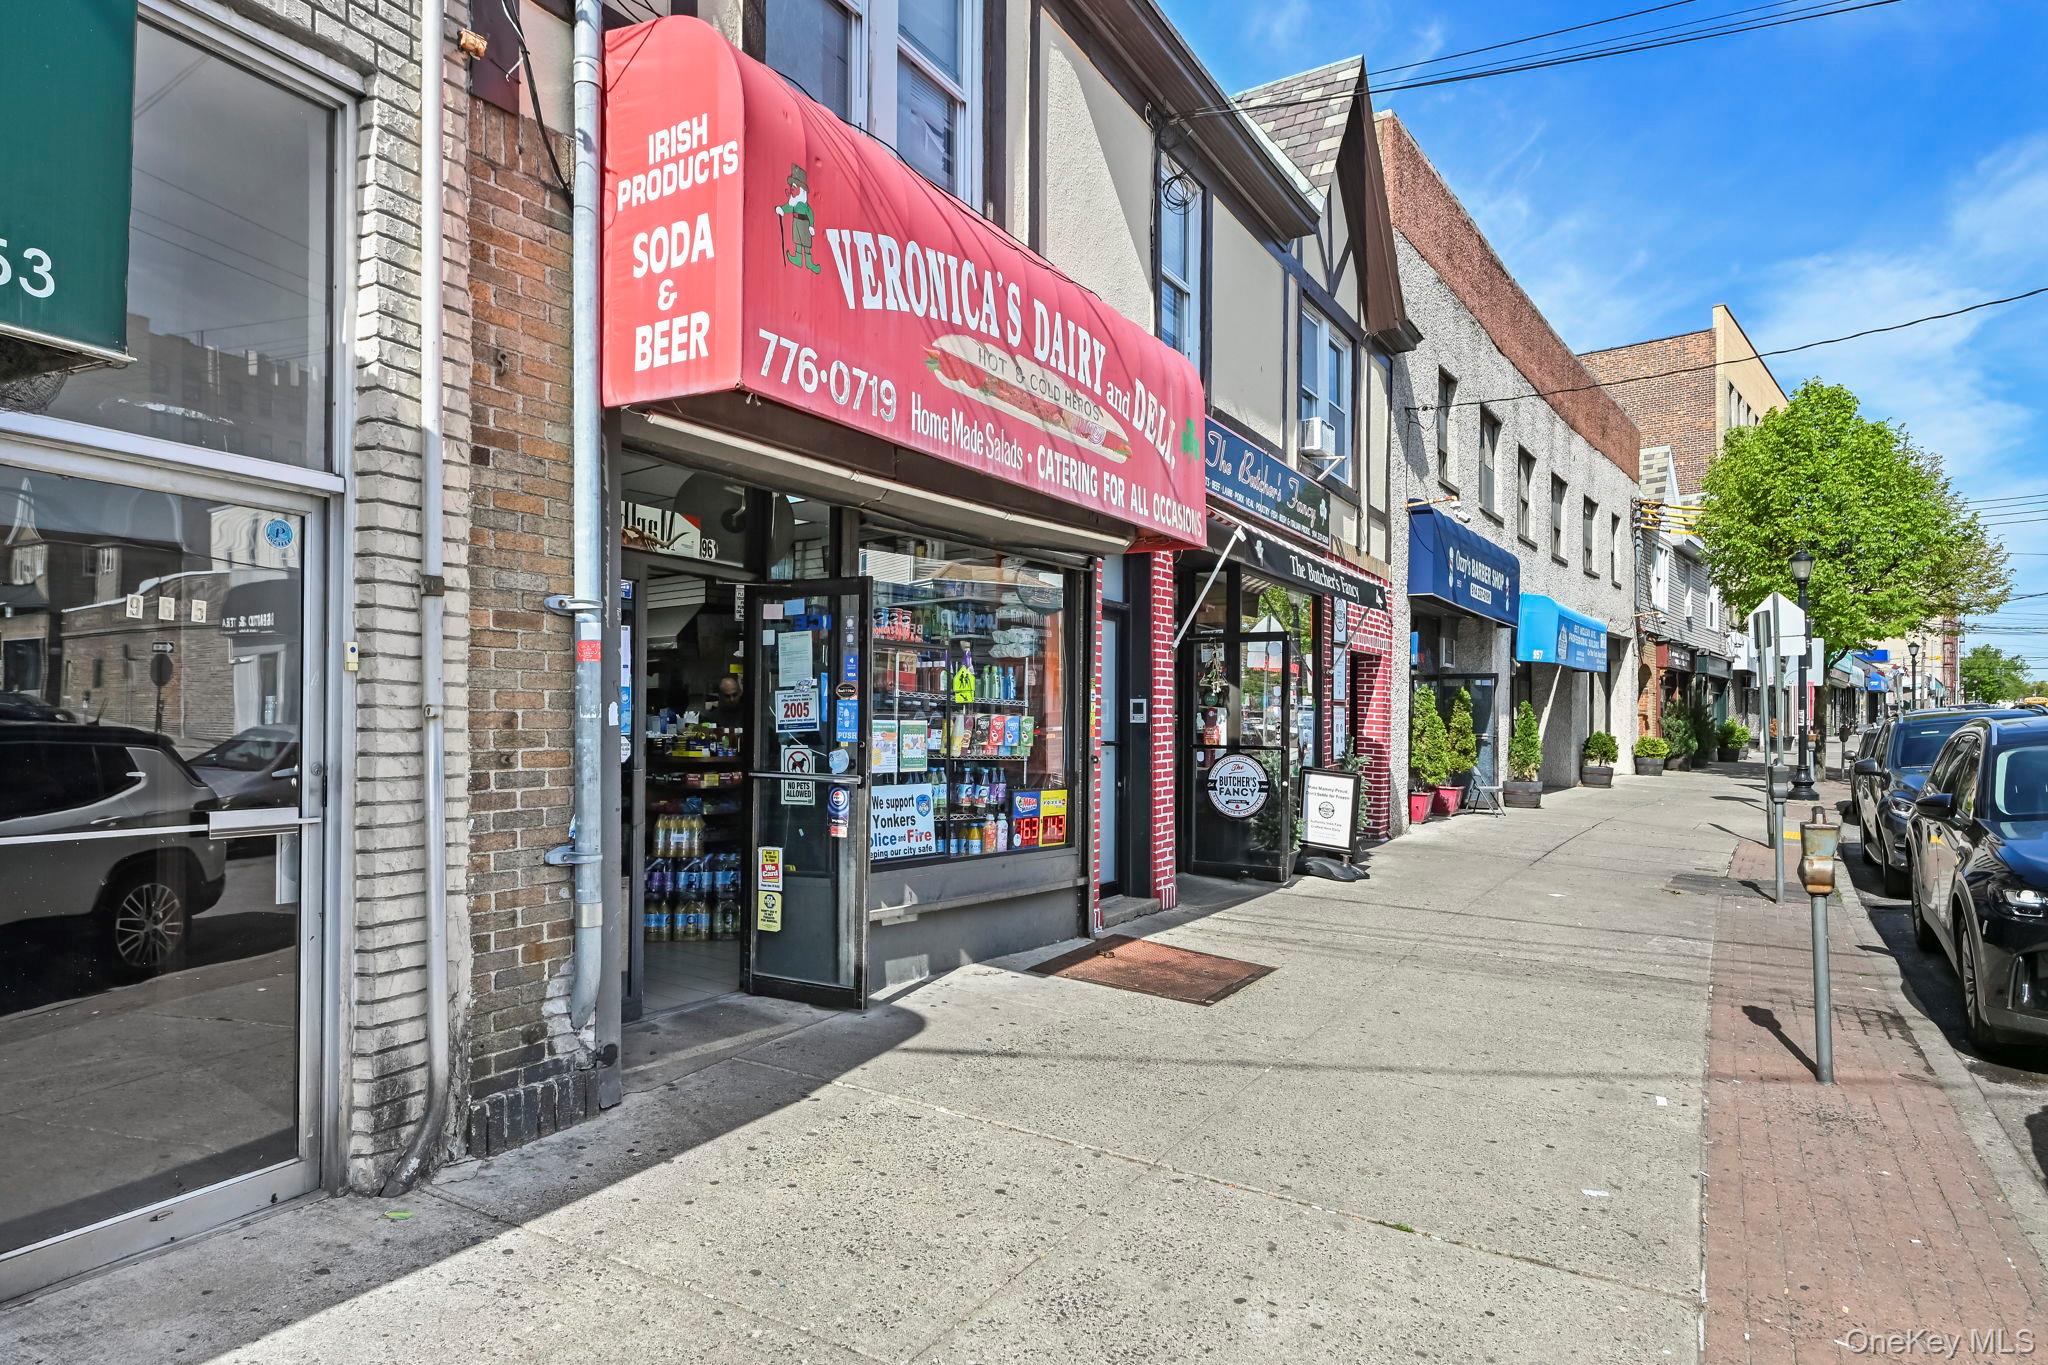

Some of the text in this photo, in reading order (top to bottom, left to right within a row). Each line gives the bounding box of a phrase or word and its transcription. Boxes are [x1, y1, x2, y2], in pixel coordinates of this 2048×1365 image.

[648, 113, 708, 165] IRISH
[617, 140, 738, 212] PRODUCTS
[633, 212, 715, 279] SODA
[657, 278, 678, 311] &
[826, 228, 1021, 347] VERONICA'S
[1033, 298, 1106, 396] DAIRY
[1106, 381, 1131, 421] and
[635, 311, 710, 372] BEER
[978, 347, 1100, 422] HOT & COLD HEROS
[911, 391, 1023, 470] Home Made Salads
[1037, 445, 1203, 538] CATERING FOR ALL OCCASIONS
[1205, 430, 1316, 529] The Butcher's Fancy
[1289, 554, 1360, 604] The Butcher's Fancy
[1471, 558, 1492, 586] BARBER
[1492, 569, 1504, 591] SHOP
[783, 702, 810, 719] 2005
[837, 732, 857, 740] PUSH
[1219, 776, 1257, 788] BUTCHER'S
[1231, 763, 1244, 771] The
[786, 789, 811, 798] ALLOWED
[788, 781, 810, 790] NO PETS
[1219, 787, 1257, 797] FANCY
[871, 794, 914, 812] We support
[872, 814, 916, 829] Yonkers
[870, 832, 897, 848] olice
[906, 829, 932, 844] Fire
[870, 843, 933, 859] eping our city safe
